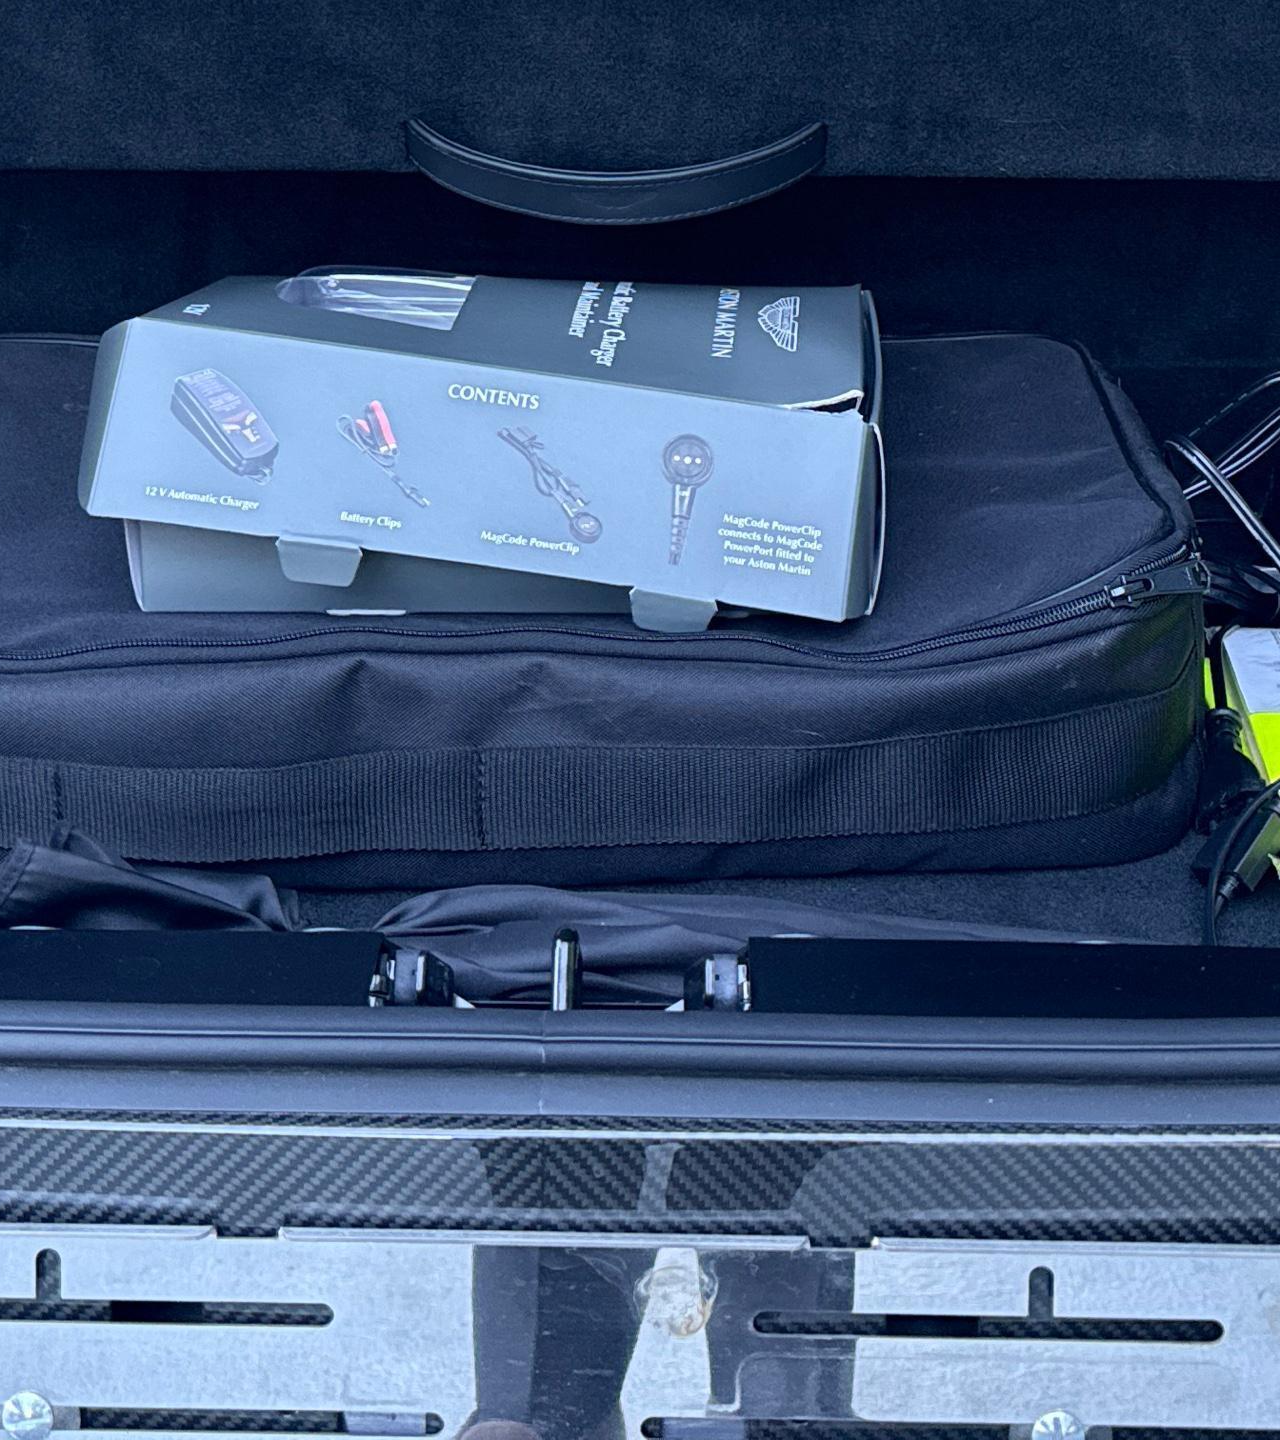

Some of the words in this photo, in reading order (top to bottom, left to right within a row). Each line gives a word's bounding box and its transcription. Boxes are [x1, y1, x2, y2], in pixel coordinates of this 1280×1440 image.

[568, 292, 601, 338] Maintainer
[599, 296, 633, 328] Battery
[590, 328, 626, 367] Charger
[711, 312, 737, 358] MARTIN
[448, 383, 540, 409] CONTENTS
[145, 486, 158, 496] 12
[159, 487, 167, 497] V
[168, 488, 218, 504] Automatic
[219, 495, 259, 511] Charger
[340, 511, 375, 527] Battery
[376, 516, 402, 530] Clips
[723, 513, 770, 529] MagCode
[771, 520, 822, 539] PowerClip
[480, 530, 528, 546] MagCode
[529, 538, 580, 555] PowerClip
[718, 528, 761, 541] connects
[763, 533, 774, 543] to
[776, 535, 823, 551] MagCode
[723, 540, 773, 557] PowerPort
[775, 547, 802, 562] fitted
[804, 553, 815, 563] to
[723, 555, 746, 566] your
[748, 557, 776, 571] Aston
[778, 562, 812, 576] Martin
